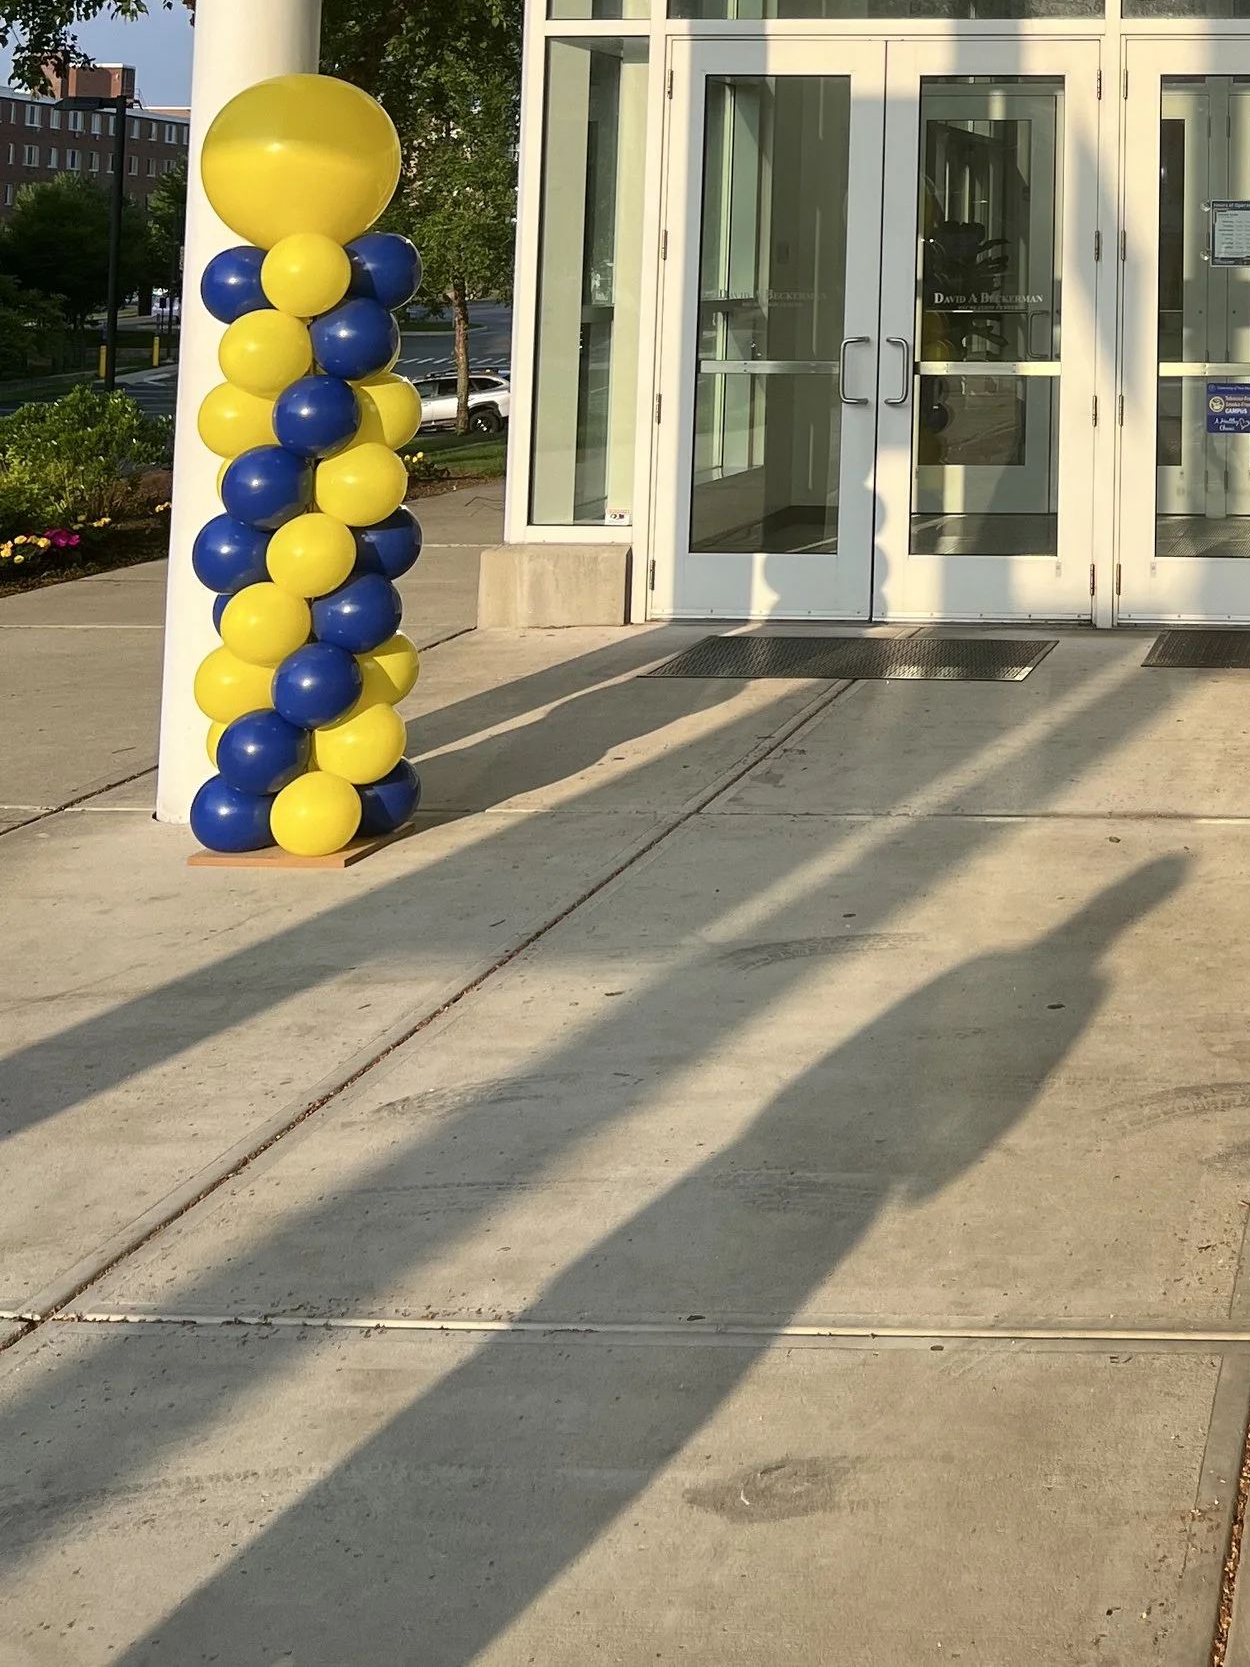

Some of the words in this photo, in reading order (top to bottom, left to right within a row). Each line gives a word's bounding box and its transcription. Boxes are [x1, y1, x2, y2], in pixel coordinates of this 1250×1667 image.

[934, 292, 966, 304] DAVID
[968, 293, 978, 303] A
[981, 292, 1044, 304] BECKERMAN
